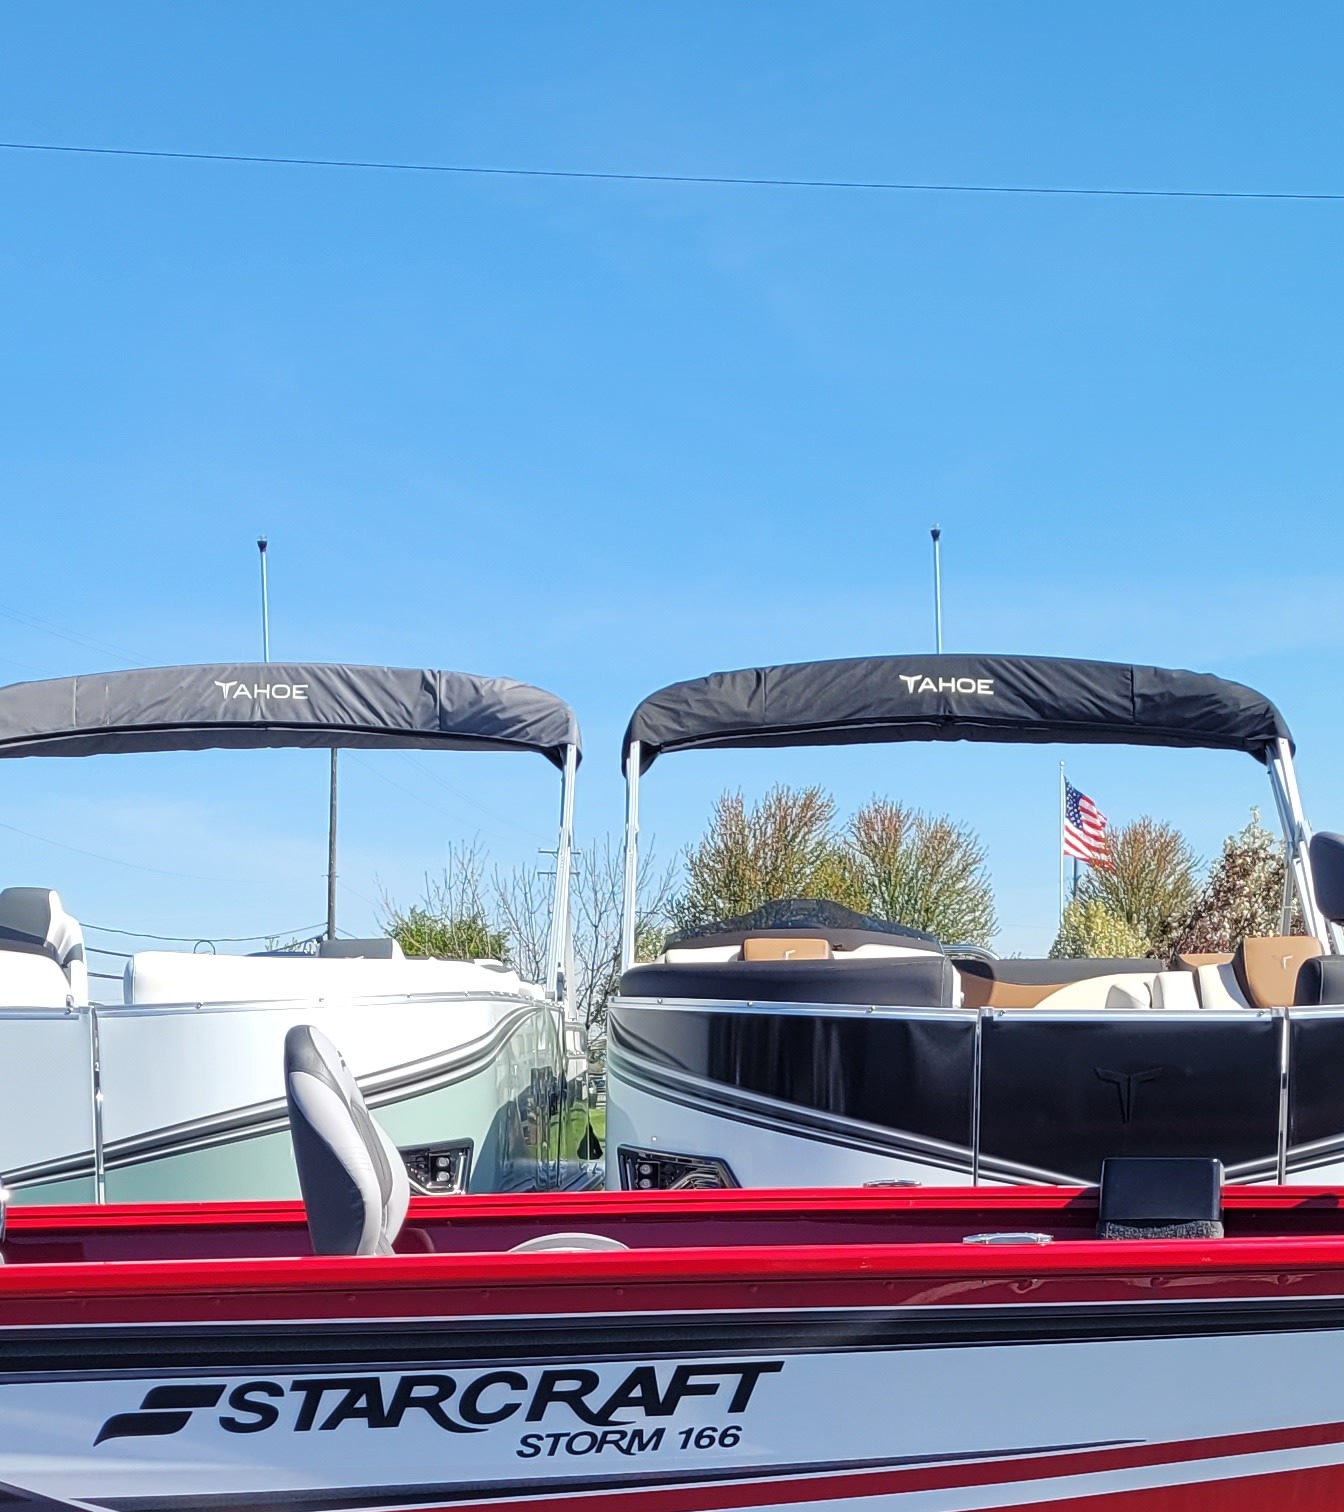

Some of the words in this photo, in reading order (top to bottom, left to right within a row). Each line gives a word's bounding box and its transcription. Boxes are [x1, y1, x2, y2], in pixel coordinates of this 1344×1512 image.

[214, 680, 309, 701] TAHOE
[899, 674, 995, 696] TAHOE
[218, 1360, 784, 1434] STARCRAFT
[516, 1428, 664, 1459] STORM
[678, 1425, 742, 1450] 166
